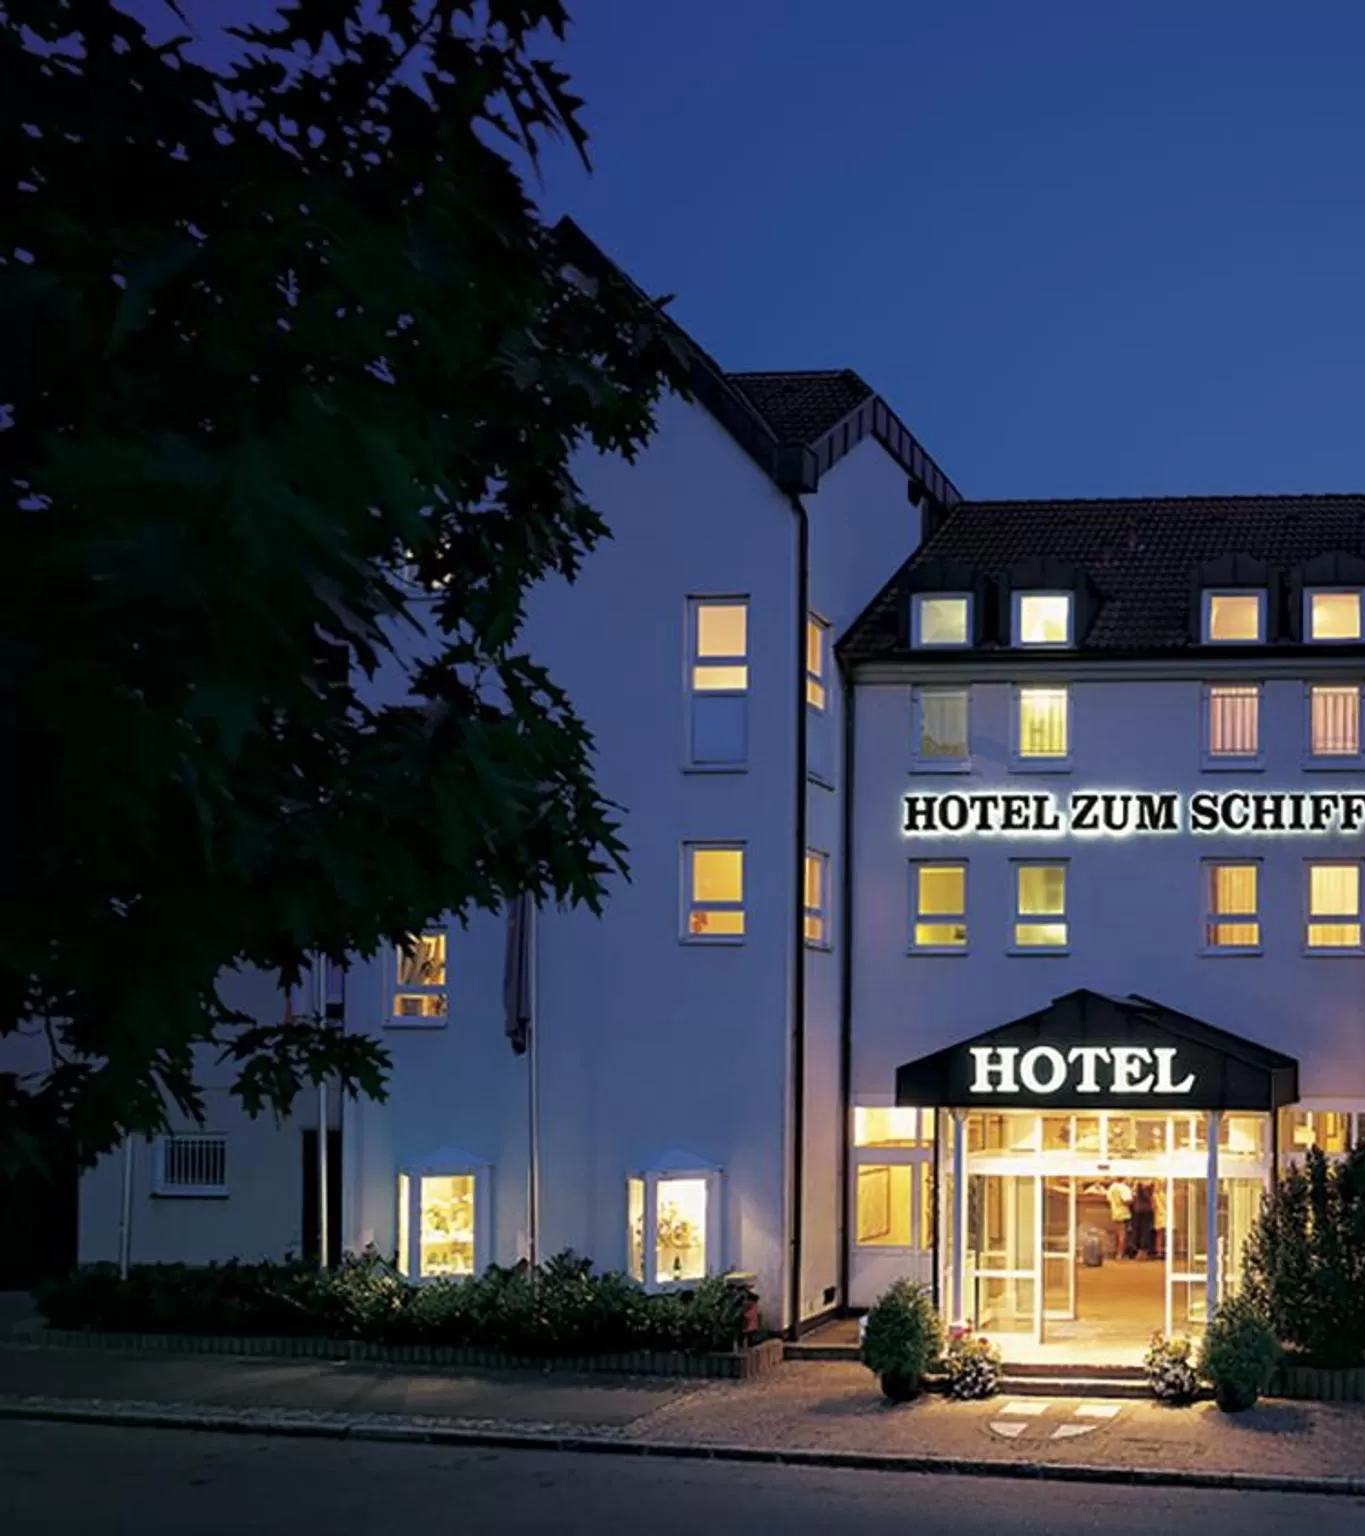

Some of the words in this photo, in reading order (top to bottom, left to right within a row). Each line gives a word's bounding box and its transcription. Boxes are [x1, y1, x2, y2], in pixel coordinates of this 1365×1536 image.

[903, 795, 1060, 831] HOTEL
[1071, 794, 1178, 830] ZUM
[969, 1046, 1196, 1093] HOTEL
